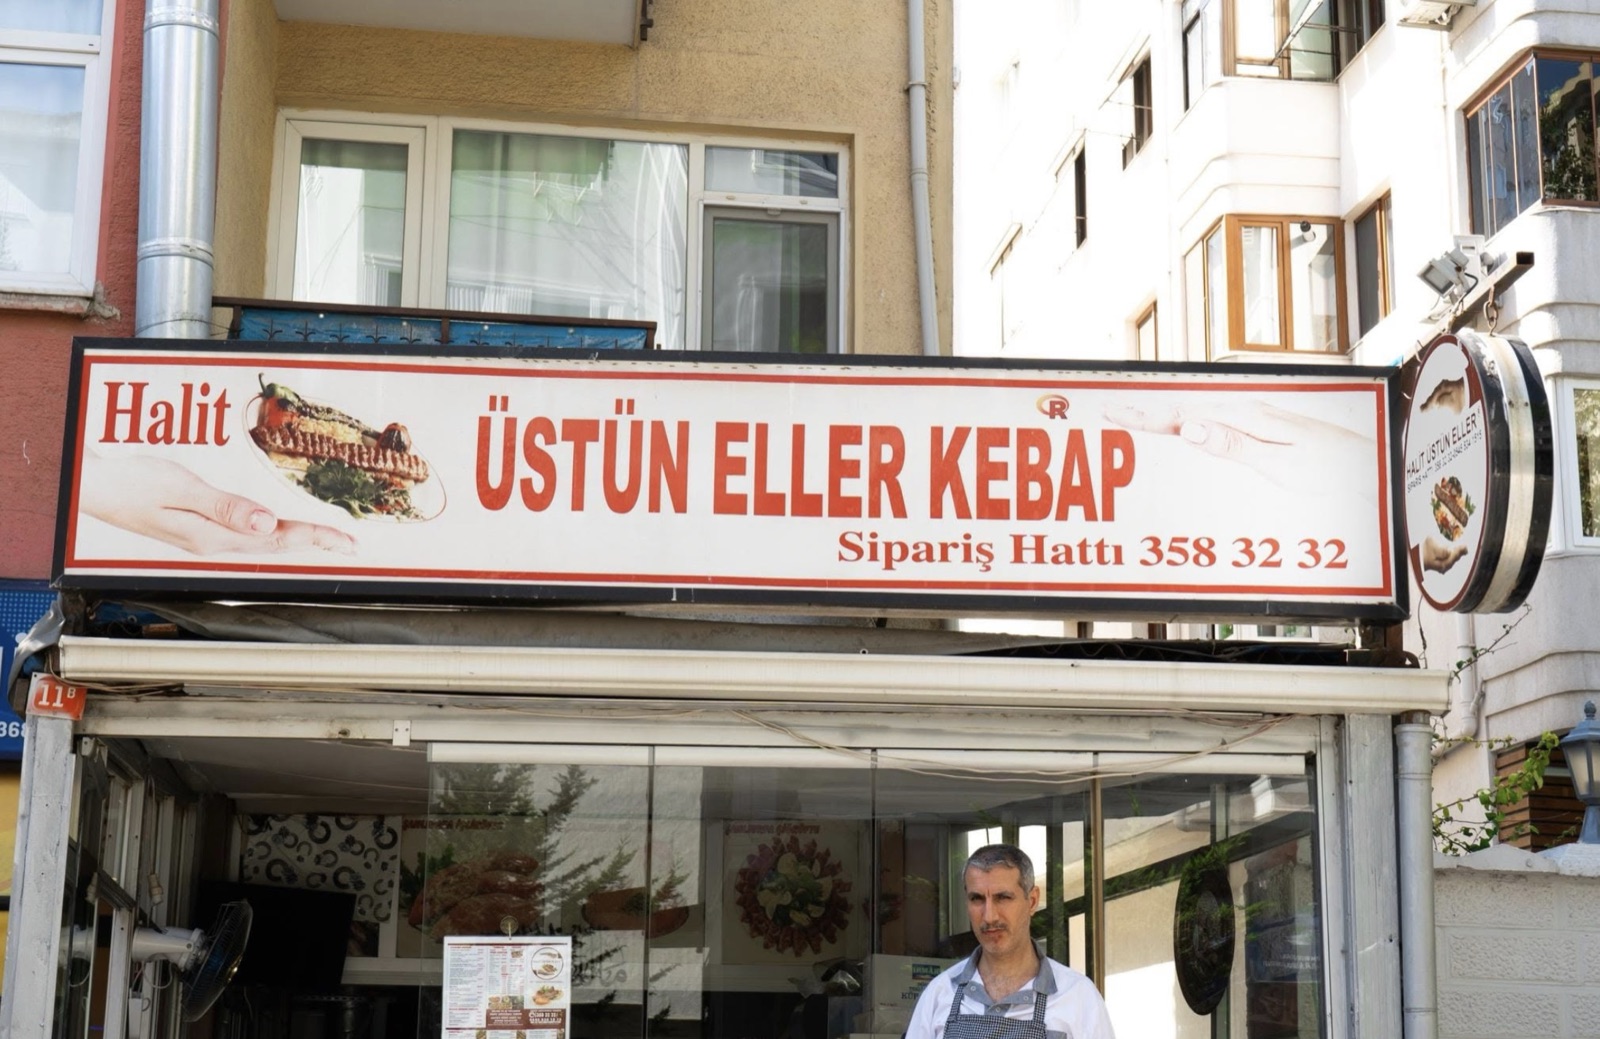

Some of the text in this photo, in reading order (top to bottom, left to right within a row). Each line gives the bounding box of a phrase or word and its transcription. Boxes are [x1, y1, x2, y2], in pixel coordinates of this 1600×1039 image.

[98, 382, 230, 446] Halit
[1452, 412, 1477, 445] ELLER
[475, 395, 1136, 522] ÜSTÜN ELLER KEBAP
[838, 530, 1348, 572] Sipariş Hattı 358 32 32
